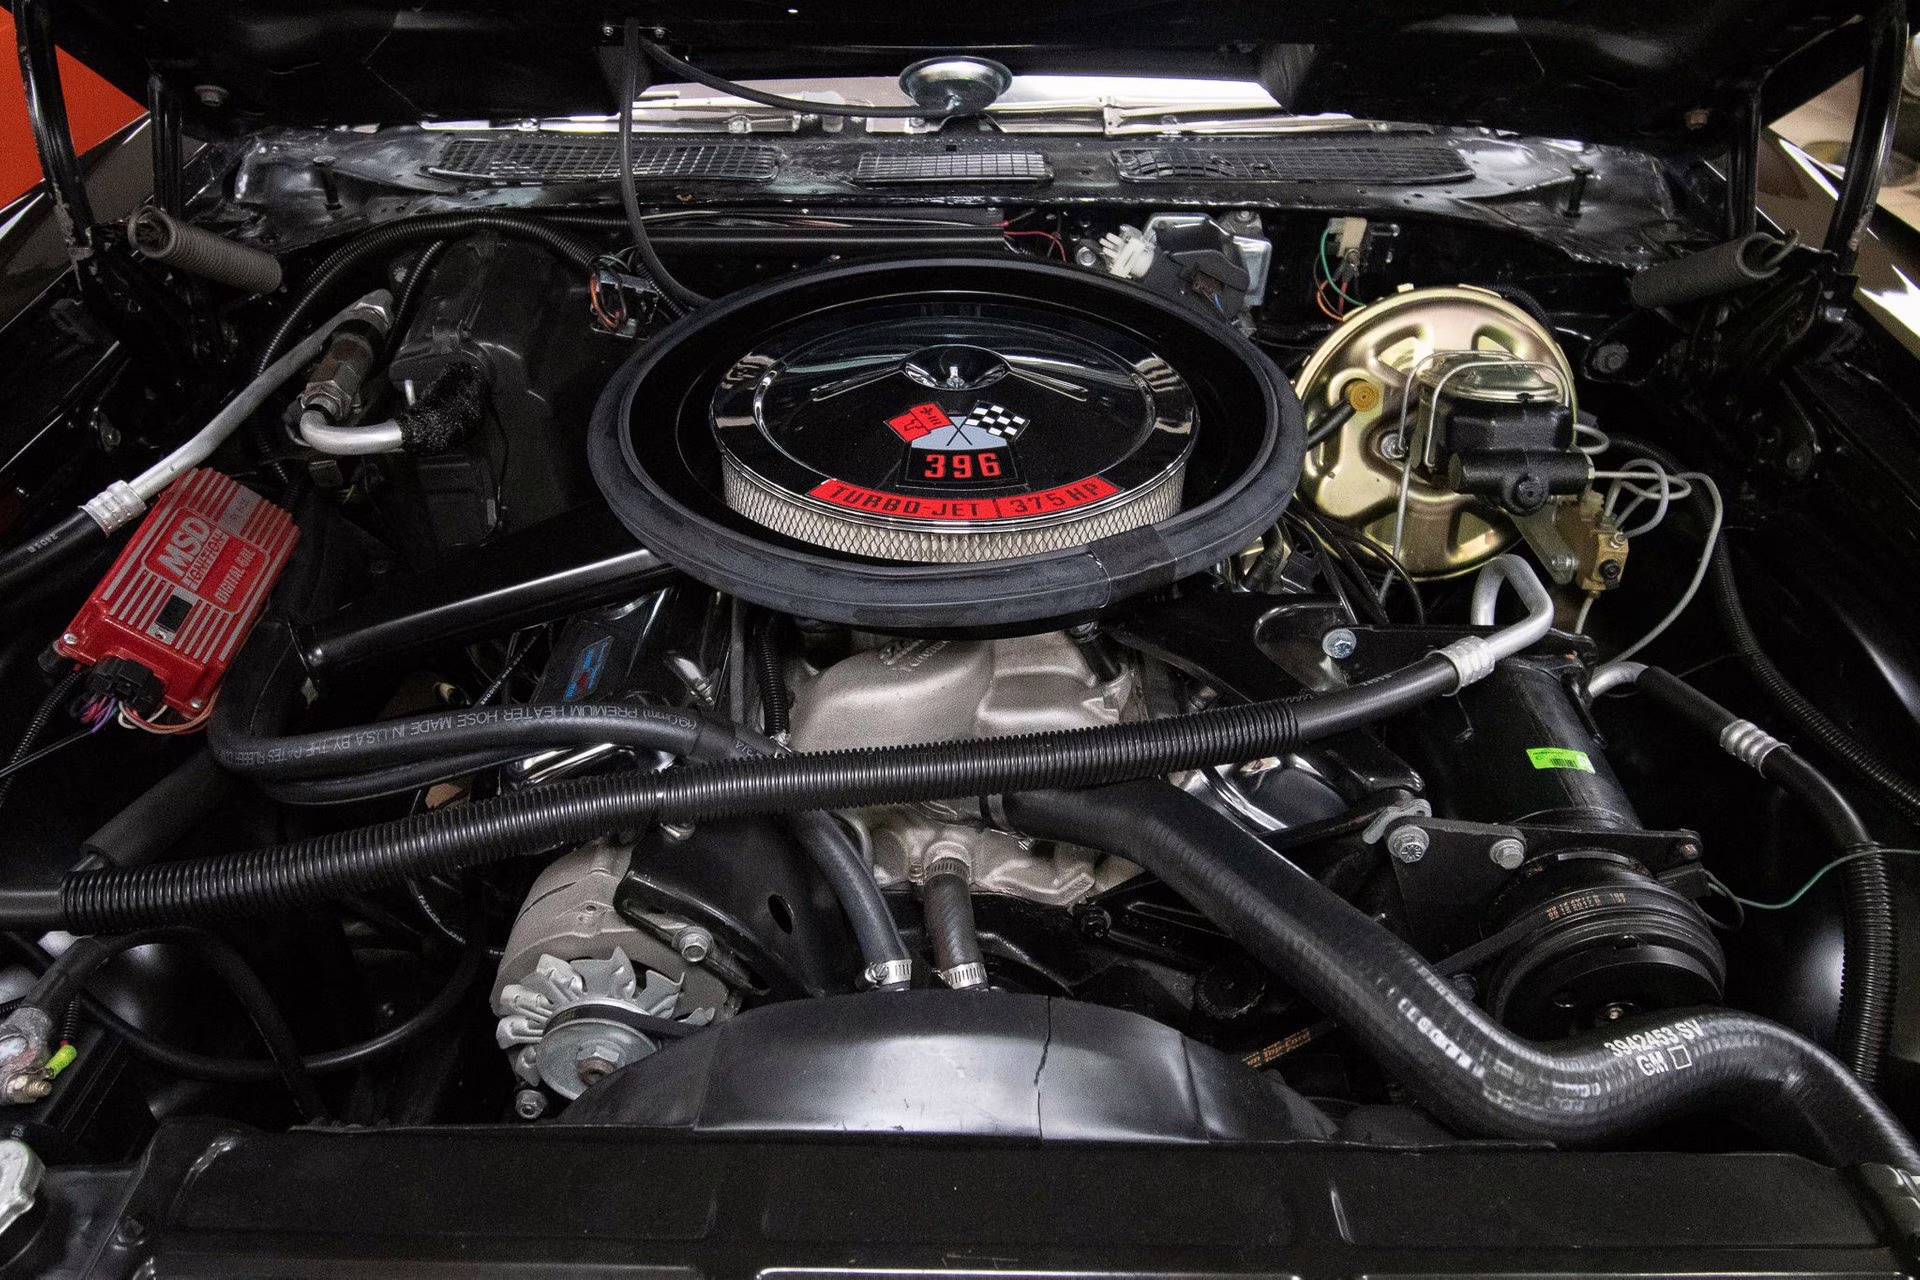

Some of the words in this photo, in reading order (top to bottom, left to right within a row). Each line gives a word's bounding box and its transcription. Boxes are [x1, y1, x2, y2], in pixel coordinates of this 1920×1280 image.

[924, 453, 1000, 479] 396
[828, 484, 978, 518] TURBO-JET
[1009, 493, 1066, 514] 375
[1068, 482, 1100, 504] HP
[157, 516, 210, 577] MSD
[457, 710, 498, 728] HOSE
[503, 705, 566, 721] HEATER
[570, 705, 638, 719] PREMIUM
[393, 723, 405, 741] IN
[410, 717, 452, 736] MADE
[333, 736, 350, 751] BY
[268, 747, 303, 763] GATES
[1603, 1027, 1680, 1058] 3942453
[1674, 1019, 1705, 1040] SV
[1636, 1050, 1669, 1076] GM
